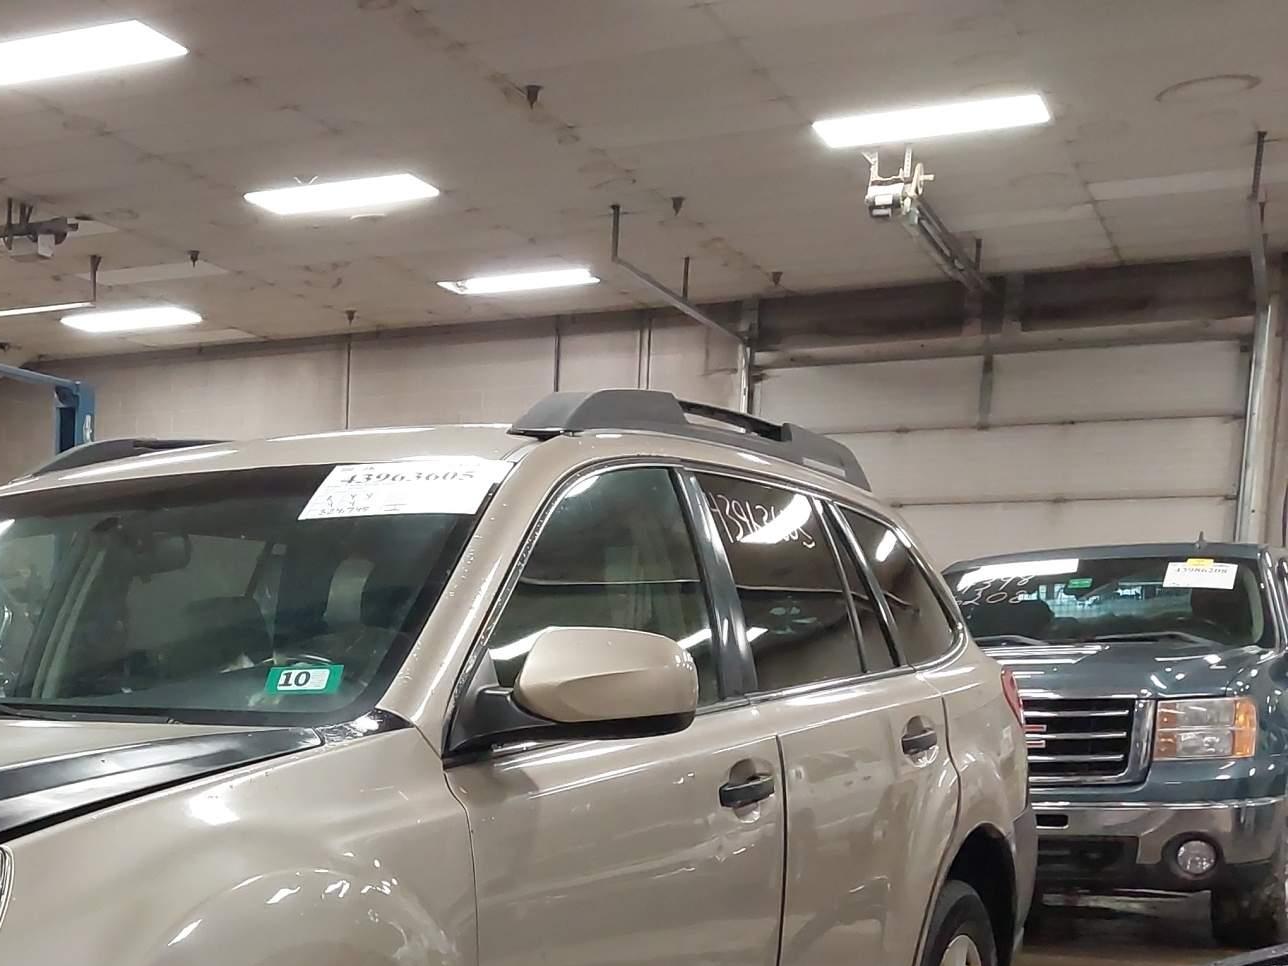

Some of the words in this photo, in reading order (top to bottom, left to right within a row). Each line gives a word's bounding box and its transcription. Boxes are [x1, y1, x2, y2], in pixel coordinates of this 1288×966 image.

[340, 471, 476, 485] 43963605
[961, 574, 1034, 595] 398
[278, 671, 311, 687] 10
